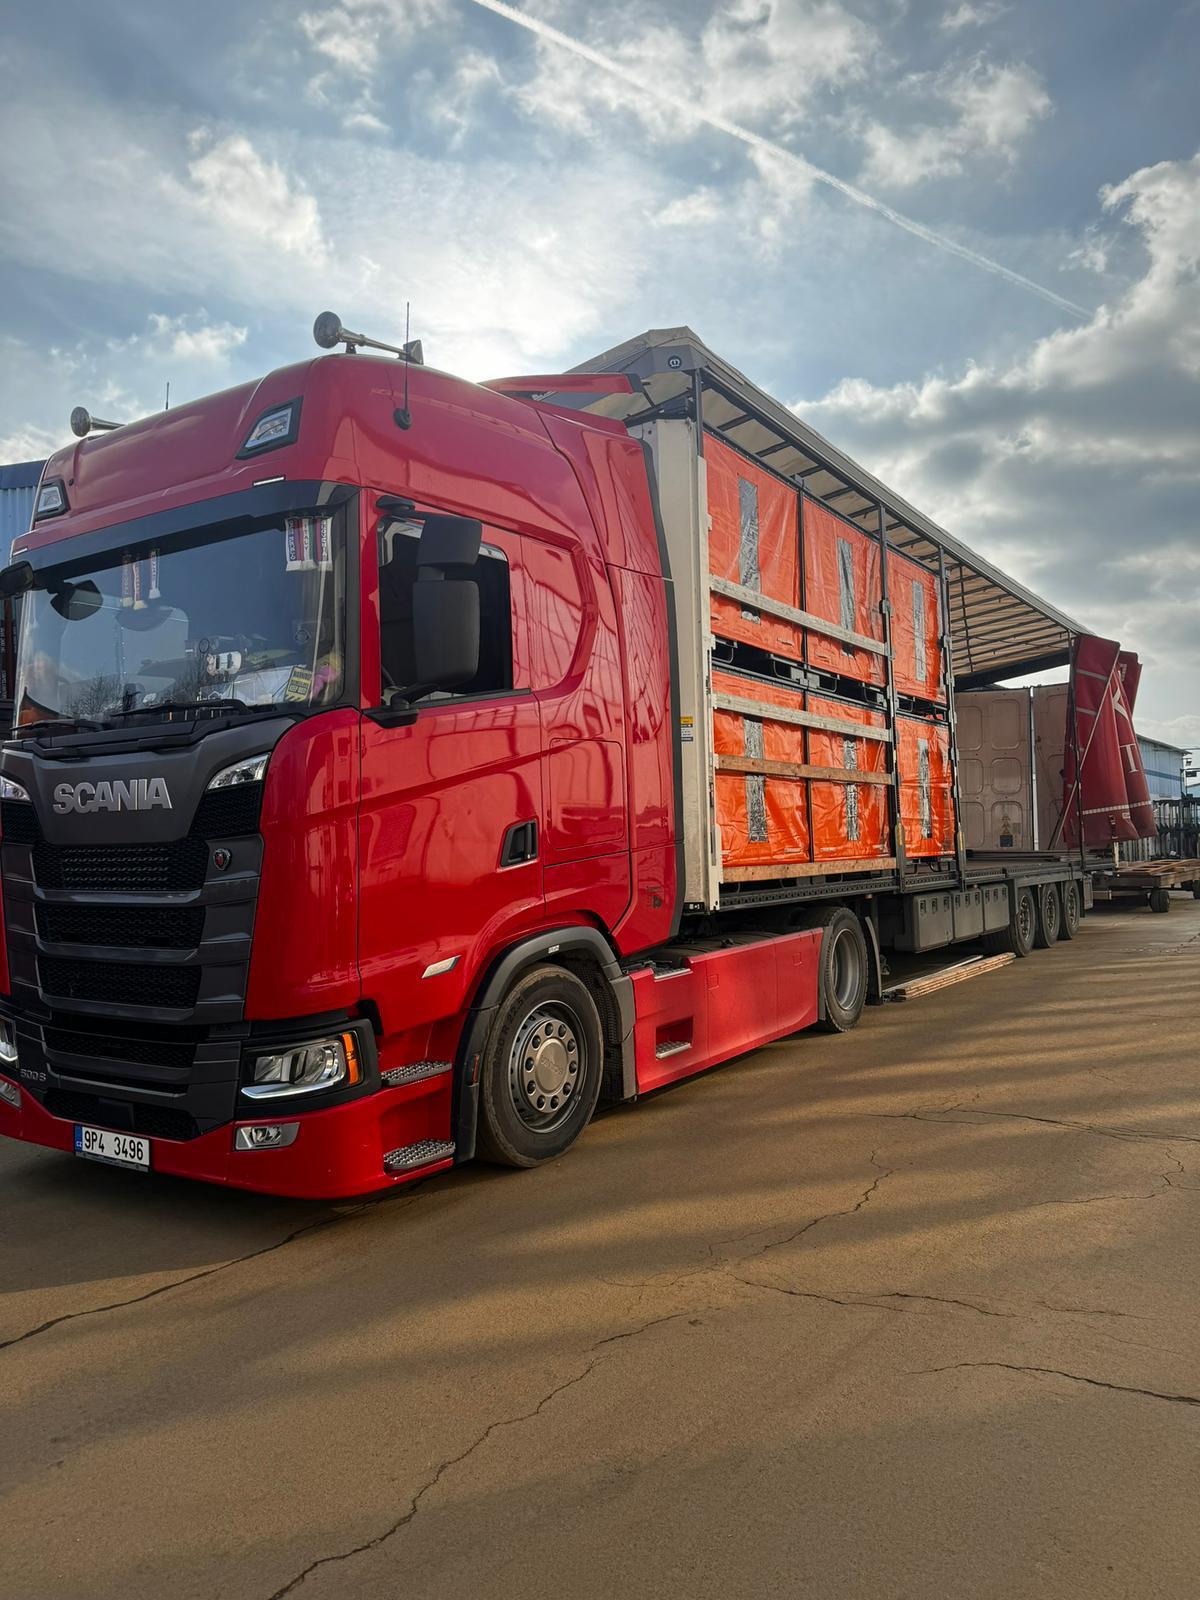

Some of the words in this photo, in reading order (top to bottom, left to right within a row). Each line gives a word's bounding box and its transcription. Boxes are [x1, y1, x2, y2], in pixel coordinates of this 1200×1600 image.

[53, 778, 172, 814] SCANIA
[84, 1130, 104, 1152] 9P4
[114, 1136, 144, 1160] 3496
